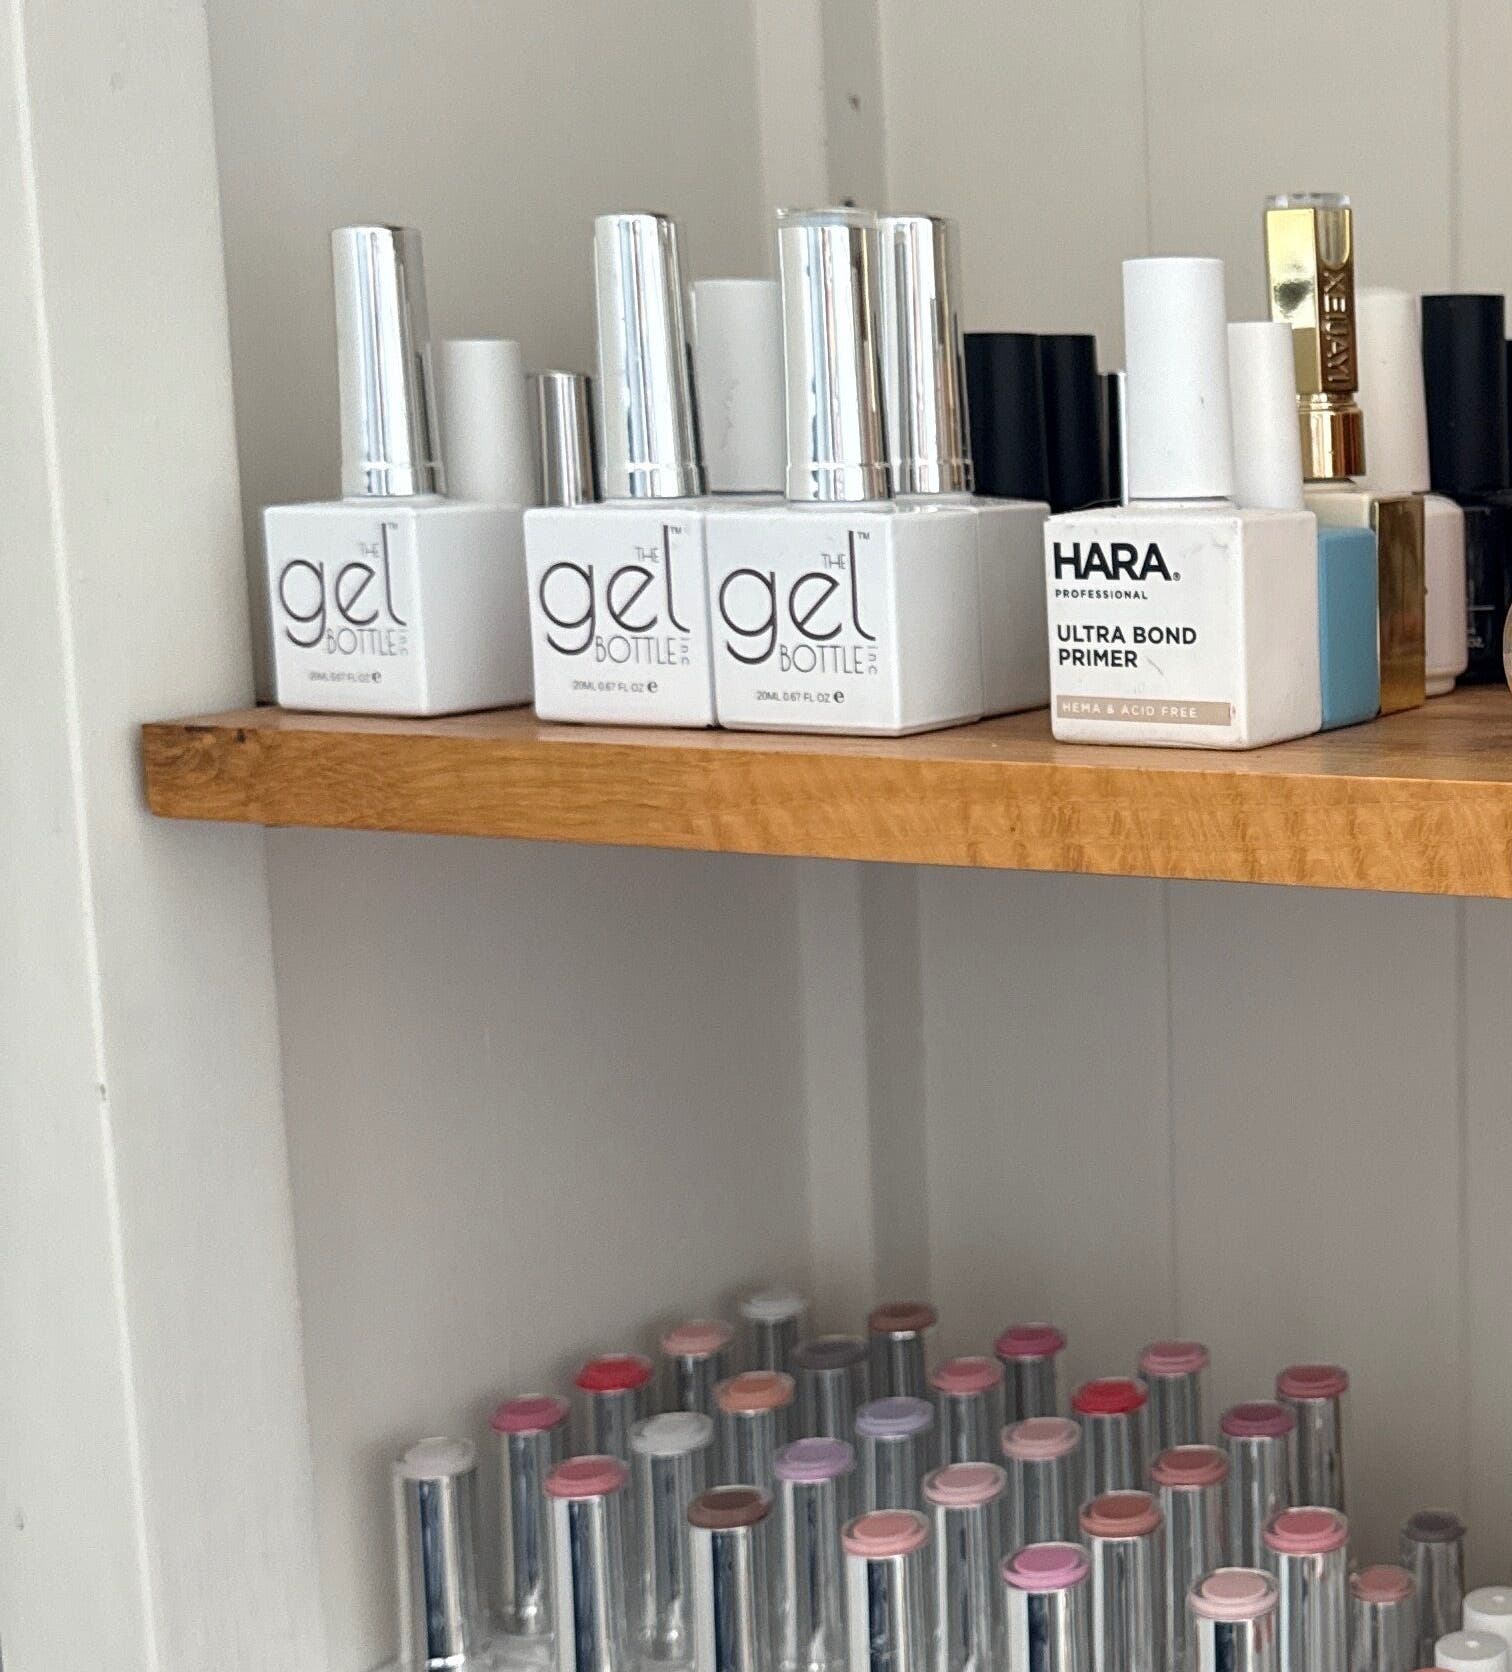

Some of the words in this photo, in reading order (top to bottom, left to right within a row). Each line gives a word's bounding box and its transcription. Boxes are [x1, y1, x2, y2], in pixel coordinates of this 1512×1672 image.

[634, 546, 660, 563] THE
[821, 554, 847, 570] THE
[279, 523, 407, 648] gel
[539, 525, 691, 656] gel
[718, 530, 877, 666] gel
[1054, 588, 1149, 600] PROFESSIONAL
[327, 626, 397, 656] BOTTLE
[1056, 623, 1127, 645] ULTRA
[1132, 626, 1198, 645] BOND
[595, 635, 678, 664] BOTTLE
[779, 643, 865, 675] BOTTLE
[1058, 648, 1139, 669] PRIMER
[1061, 702, 1101, 714] HEMA
[1120, 704, 1156, 716] ACID
[1160, 706, 1200, 719] FREE
